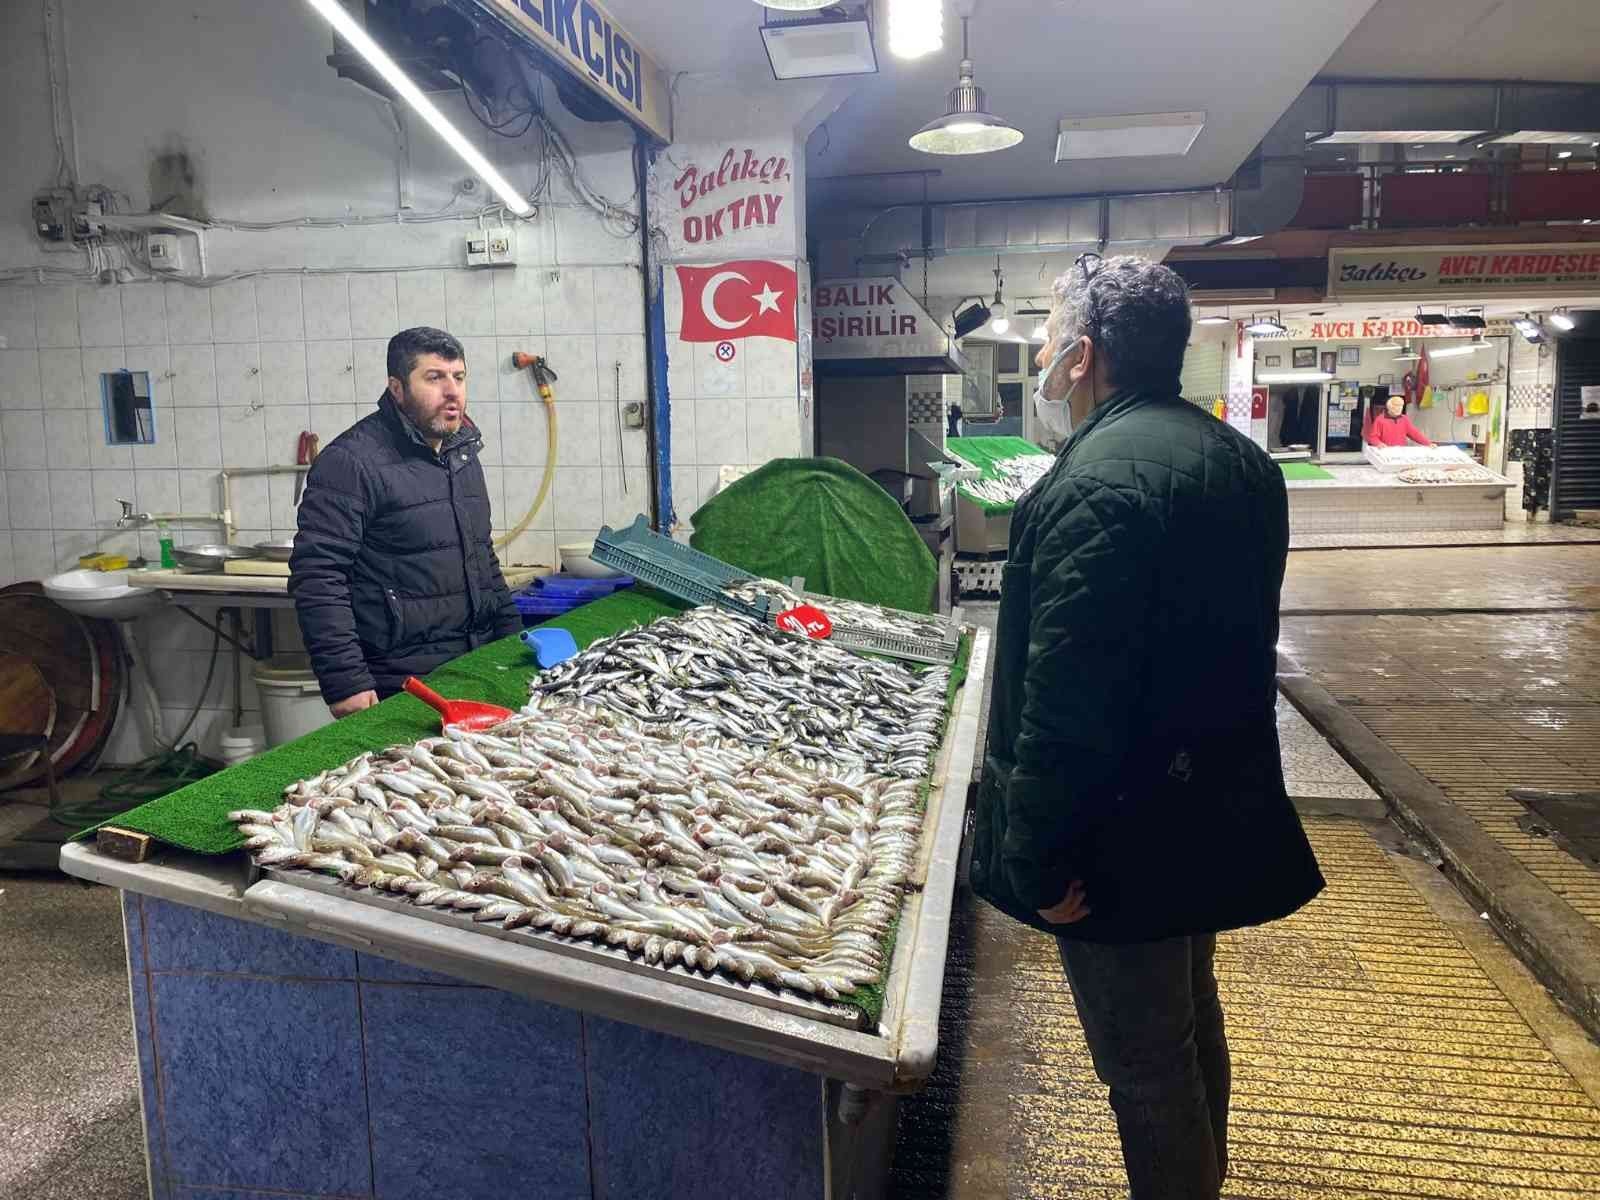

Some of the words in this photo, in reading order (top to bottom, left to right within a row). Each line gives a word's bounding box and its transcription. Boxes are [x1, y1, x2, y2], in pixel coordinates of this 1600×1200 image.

[683, 194, 783, 243] OKTAY
[1439, 256, 1488, 275] AVCI
[815, 284, 895, 307] BALIK
